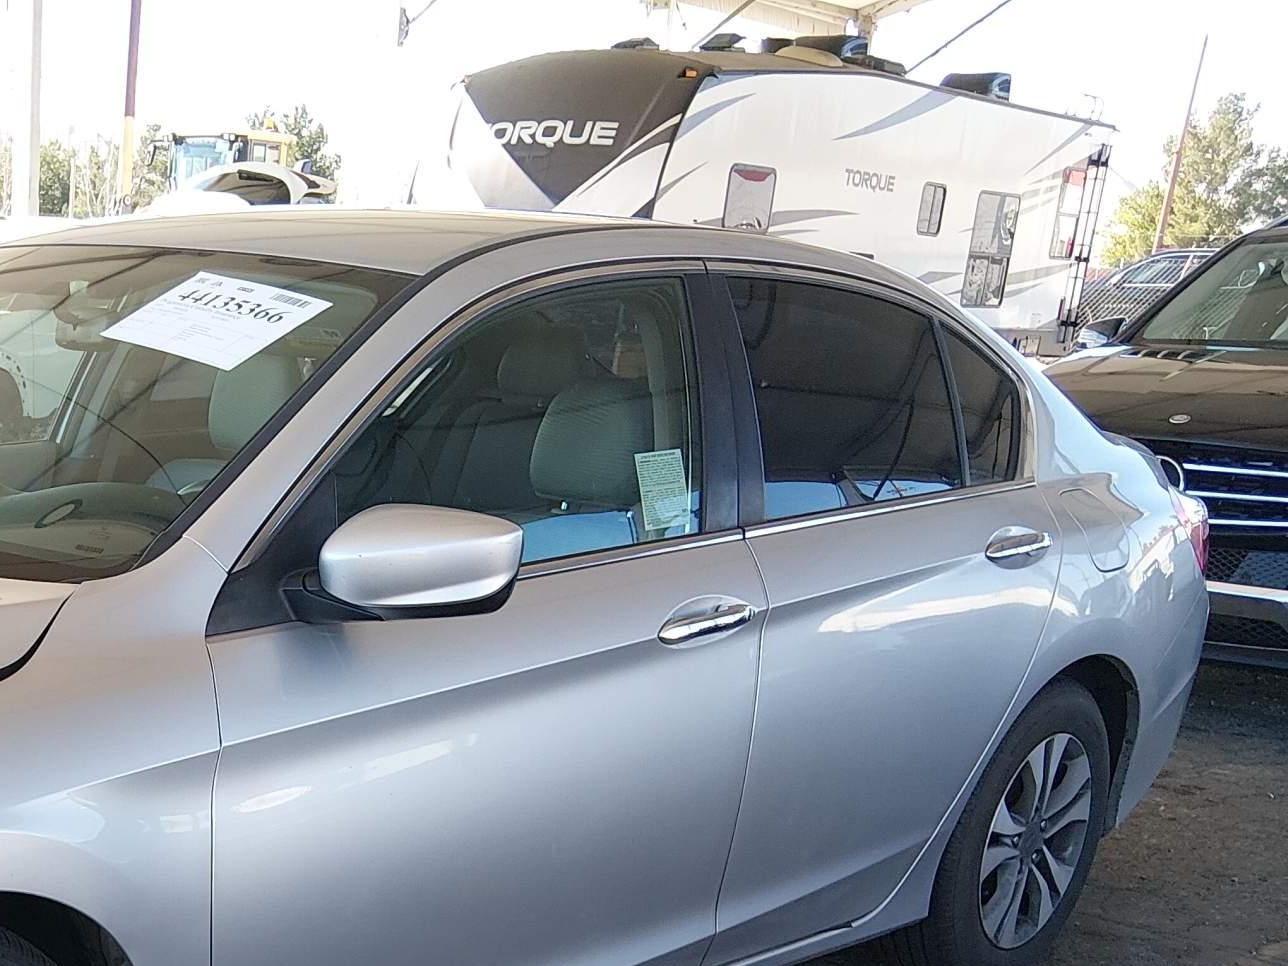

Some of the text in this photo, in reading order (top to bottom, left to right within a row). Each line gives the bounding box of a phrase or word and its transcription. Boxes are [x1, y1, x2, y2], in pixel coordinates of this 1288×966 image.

[488, 119, 620, 148] ORQUE
[845, 168, 896, 193] TORQUE
[178, 289, 294, 324] 44135366
